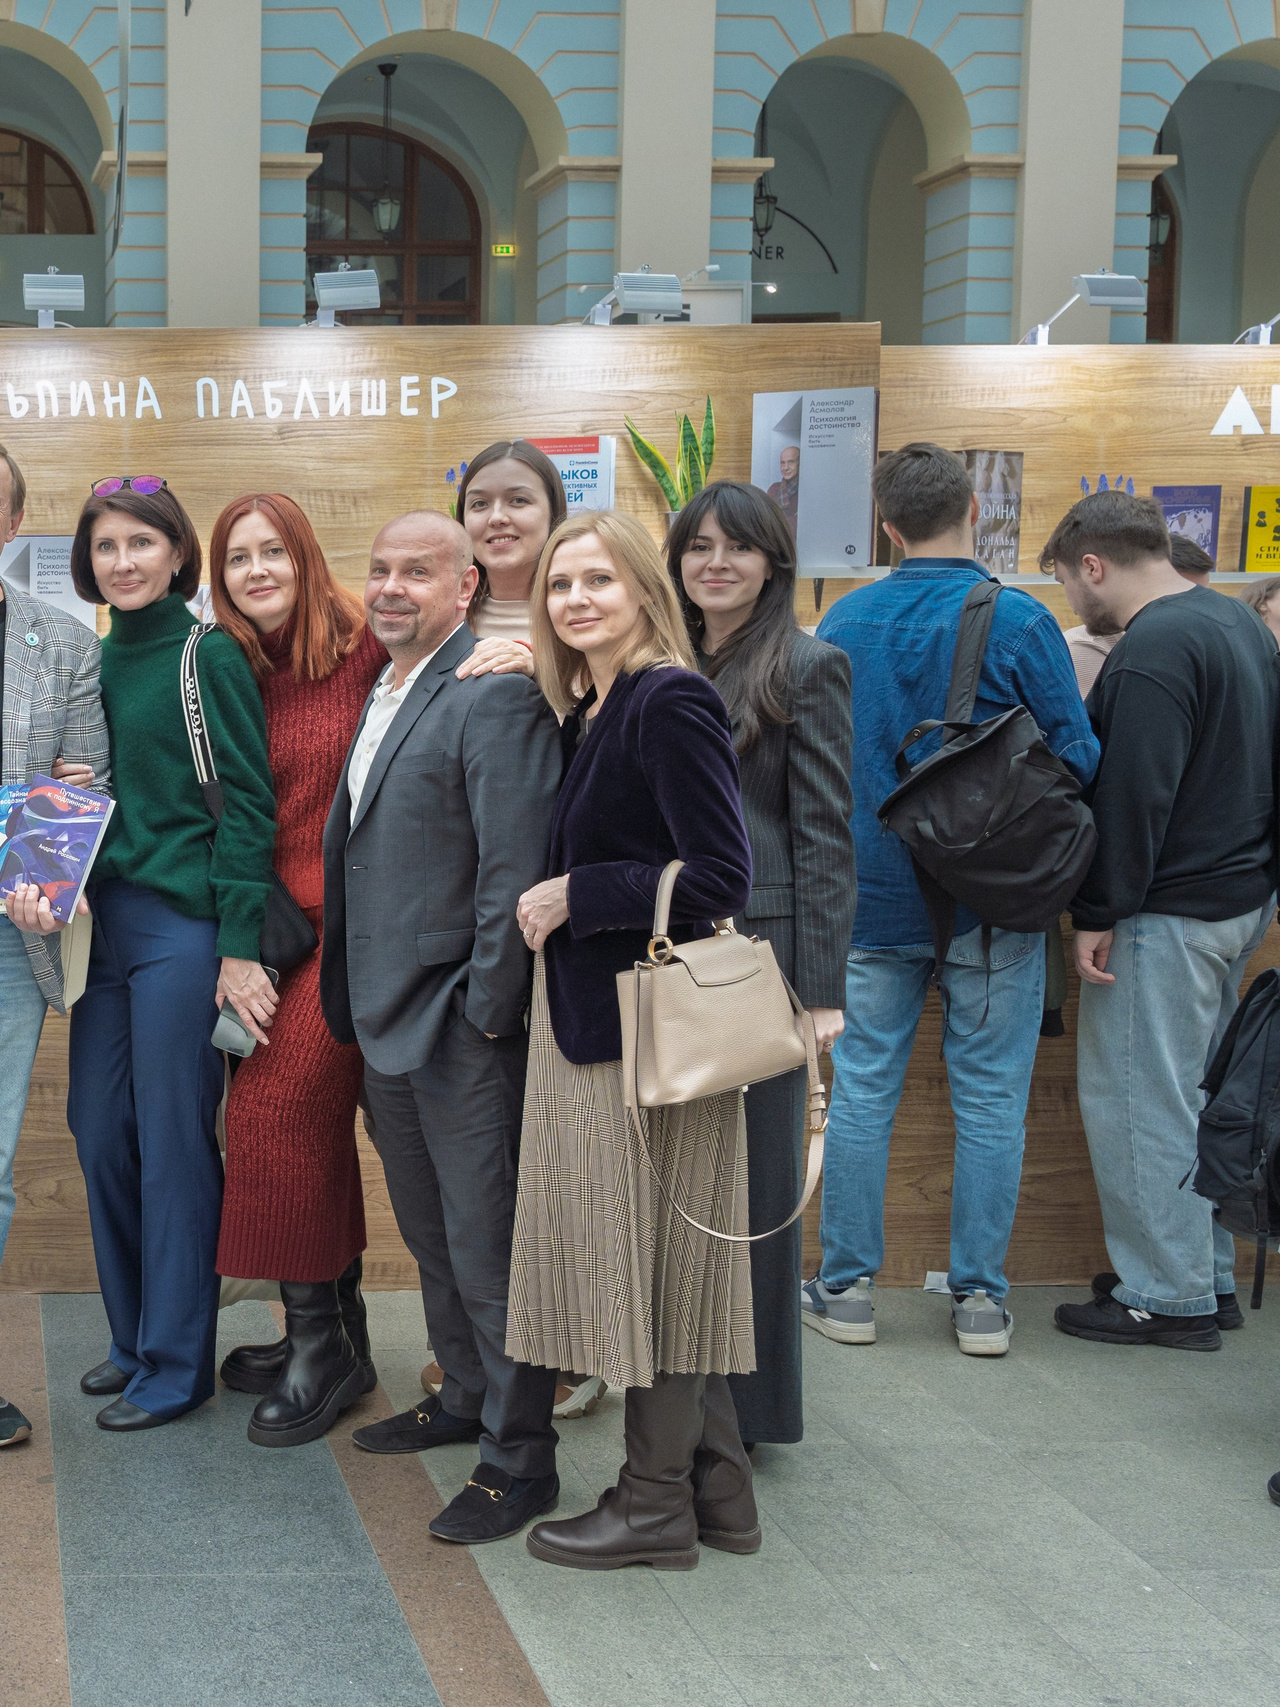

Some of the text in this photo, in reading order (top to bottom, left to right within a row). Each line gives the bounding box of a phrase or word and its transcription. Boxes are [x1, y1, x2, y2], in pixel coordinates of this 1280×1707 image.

[196, 375, 458, 420] ПАБЛИШЕР
[809, 399, 855, 407] Александр
[809, 415, 857, 423] Психология
[808, 422, 861, 431] достоинства
[561, 469, 598, 480] ЫКОВ
[567, 489, 583, 502] ЕЙ
[975, 548, 1015, 559] КАГАН
[37, 562, 71, 570] Психоло
[186, 677, 202, 739] PRADA
[59, 787, 101, 807] Путешествие
[53, 795, 92, 812] подлинному
[38, 843, 57, 854] Андрей
